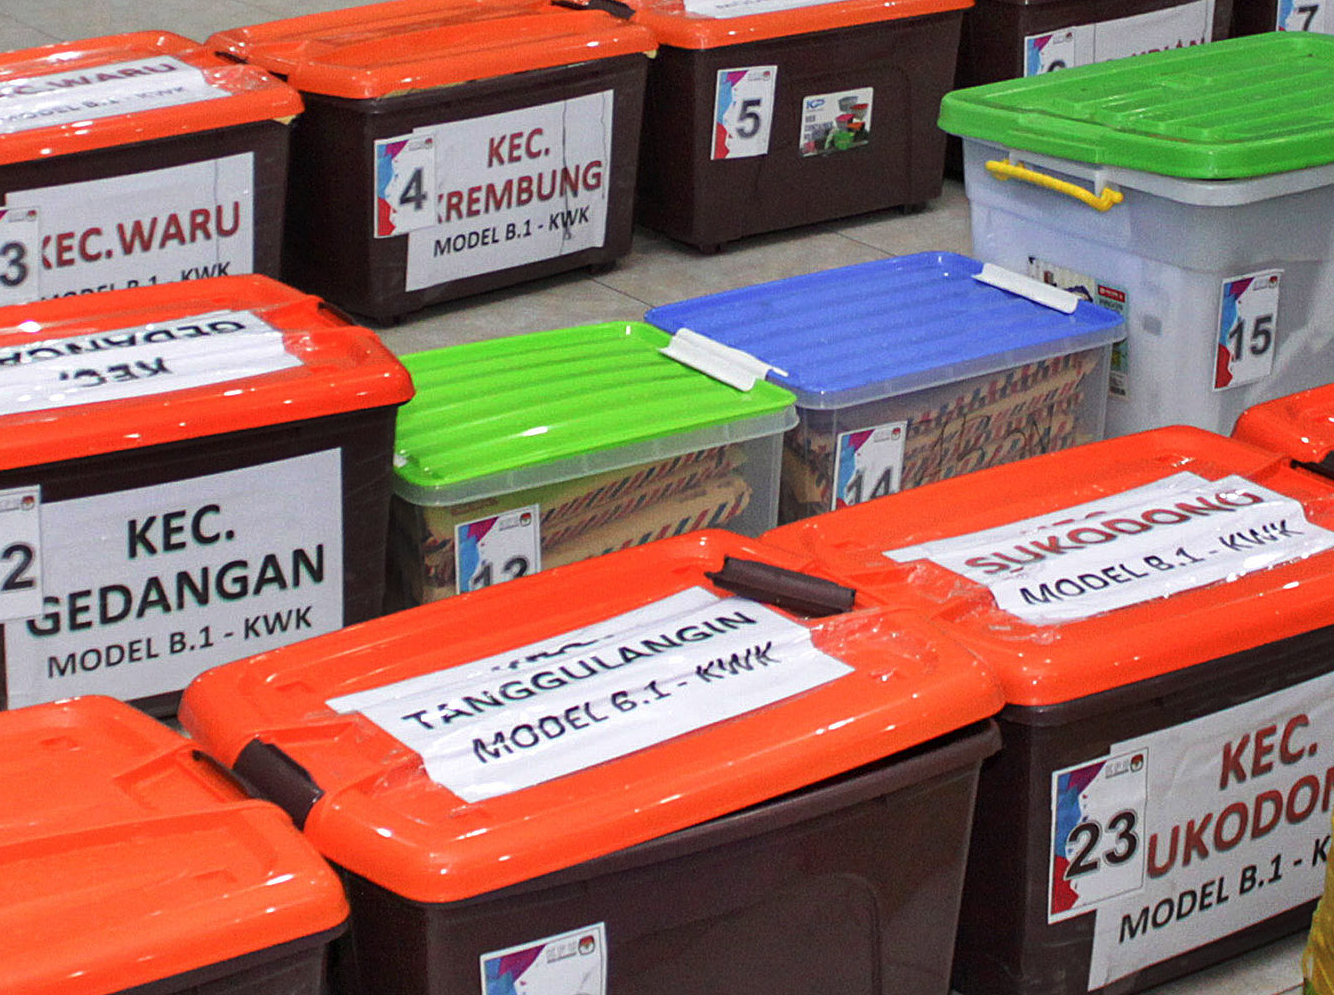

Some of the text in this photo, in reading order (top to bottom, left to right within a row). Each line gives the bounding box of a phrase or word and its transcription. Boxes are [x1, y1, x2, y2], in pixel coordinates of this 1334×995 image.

[1297, 4, 1319, 32] 7
[487, 127, 551, 168] KEC.
[736, 98, 762, 140] 5
[399, 167, 428, 211] 4
[436, 160, 604, 224] REMBUNG
[433, 204, 591, 258] MODEL B.1 KWK
[180, 261, 232, 283] KWK
[1229, 315, 1273, 362] 15
[845, 466, 893, 506] 14
[126, 503, 235, 559] KEC.
[24, 544, 326, 639] GEDANGAN
[1017, 519, 1305, 607] MODEL B.1 KWK
[46, 606, 315, 679] MODEL B.1 KWK
[401, 611, 759, 731] TANGGULANGIN
[471, 702, 610, 764] MODEL
[693, 640, 782, 685] KWK
[1219, 713, 1318, 790] KEC.
[1066, 808, 1141, 881] 23
[1117, 878, 1229, 946] MODEL
[1237, 851, 1284, 897] B.1
